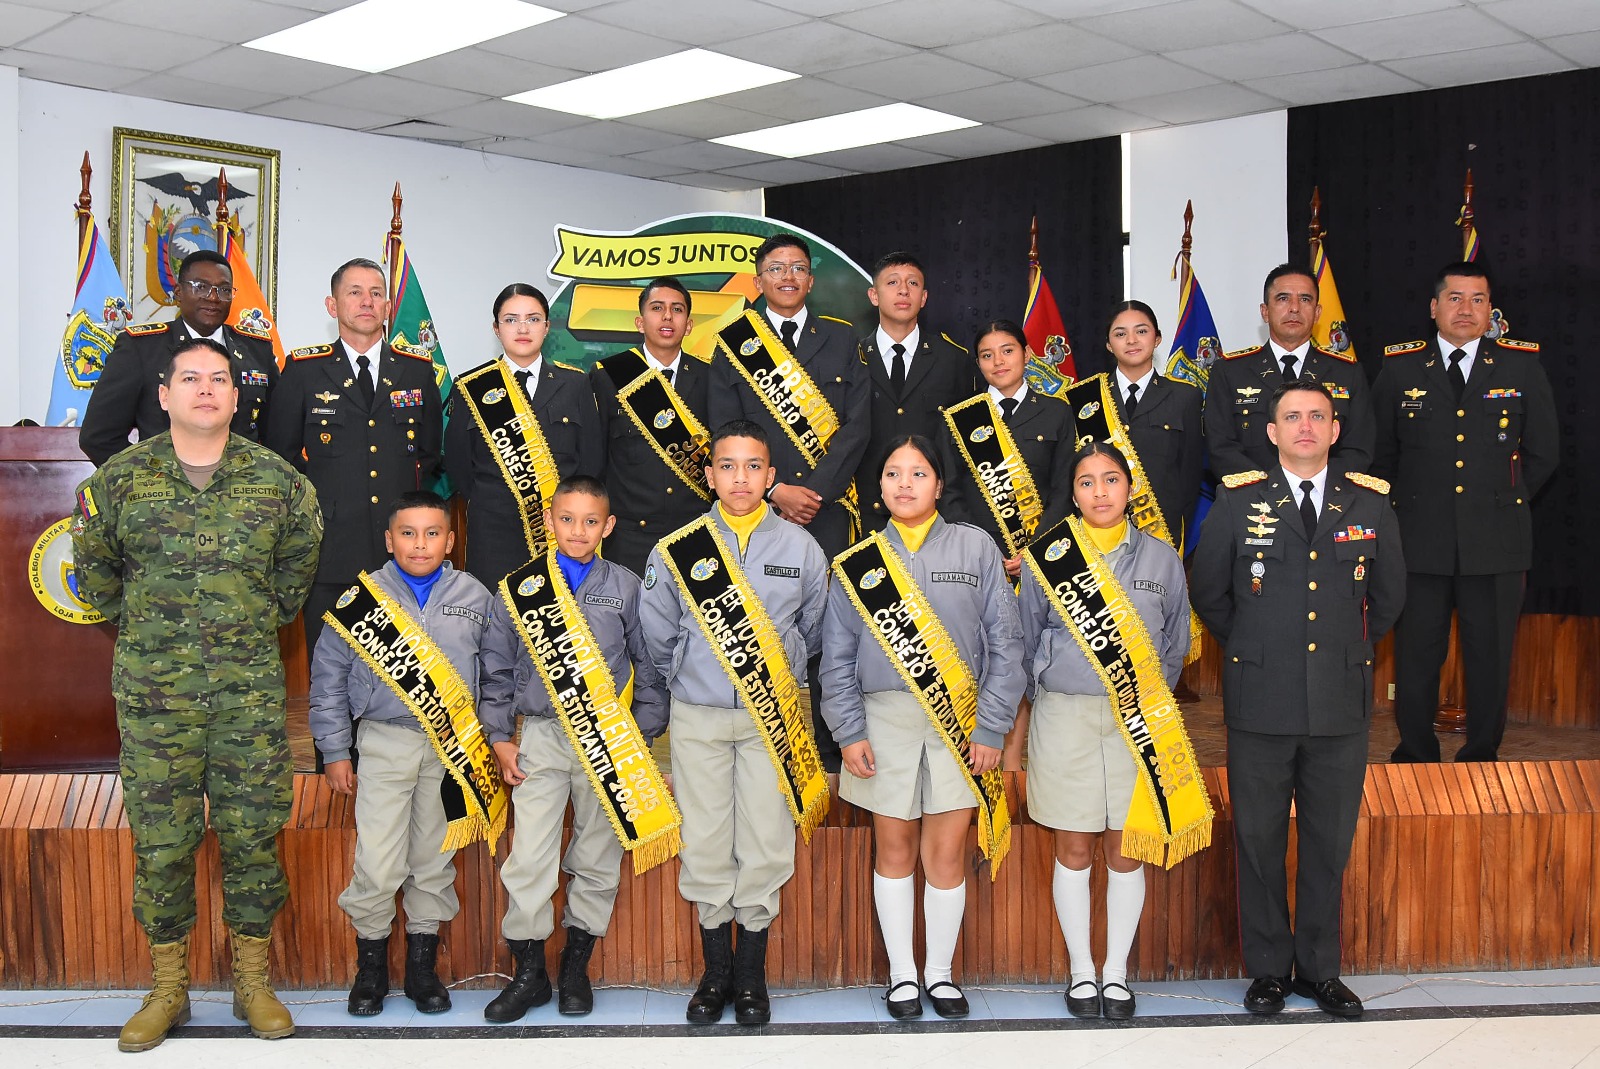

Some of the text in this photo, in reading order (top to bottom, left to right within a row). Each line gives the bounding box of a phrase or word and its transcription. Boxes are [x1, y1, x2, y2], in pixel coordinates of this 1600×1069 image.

[573, 244, 757, 267] VAMOS JUNTOS
[503, 413, 532, 435] 1ER
[753, 368, 800, 425] CONSEJO
[491, 427, 532, 490] CONSEJO
[516, 437, 554, 492] VOCAL
[128, 491, 163, 501] VELASCO
[233, 486, 278, 496] EJERCITO
[977, 461, 1015, 519] CONSEJO
[32, 524, 65, 589] COLEGIO MILITAR
[766, 567, 792, 576] CASTILLO
[53, 605, 74, 619] LOJA
[364, 600, 395, 631] 3ER
[390, 625, 440, 684] VOCAL
[538, 596, 570, 627] 2DO
[714, 584, 746, 612] 1ER
[732, 609, 780, 672] VOCAL
[889, 592, 922, 628] 3ER
[910, 621, 960, 685] VOCAL
[552, 624, 600, 686] VOCAL
[873, 608, 927, 678] CONSEJO
[700, 598, 748, 668] CONSEJO
[741, 670, 791, 764] ESTUDIANTIL
[1054, 581, 1178, 798] CONSEJO ESTUDIANTIL 2026
[1071, 562, 1193, 788] 2DA VOCAL PRINCIPAL 2025
[350, 620, 495, 807] CONSEJO ESTUDIANTIL 2026
[522, 609, 644, 822] CONSEJO ESTUDIANTIL 2026
[581, 683, 645, 771] SUPLENTE
[628, 767, 661, 812] 2025
